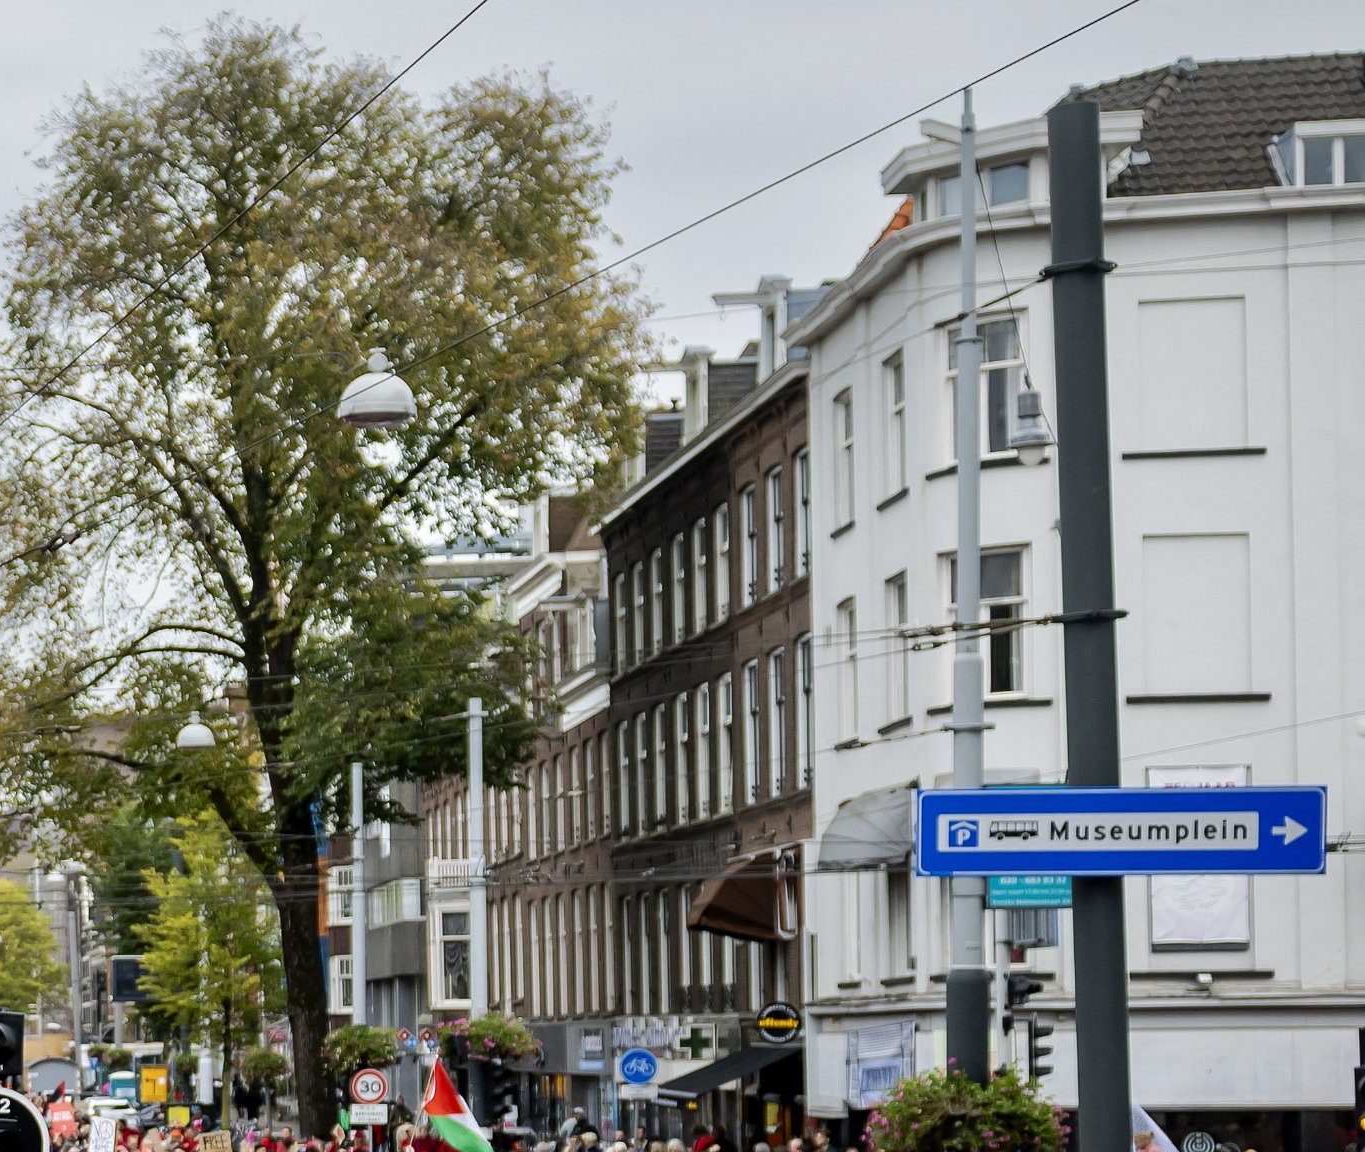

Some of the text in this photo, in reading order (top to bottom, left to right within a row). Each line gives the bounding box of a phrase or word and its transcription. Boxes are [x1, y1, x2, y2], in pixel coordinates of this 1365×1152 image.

[1050, 818, 1248, 843] Museumplein
[360, 1080, 381, 1094] 30
[203, 1133, 226, 1150] FREE
